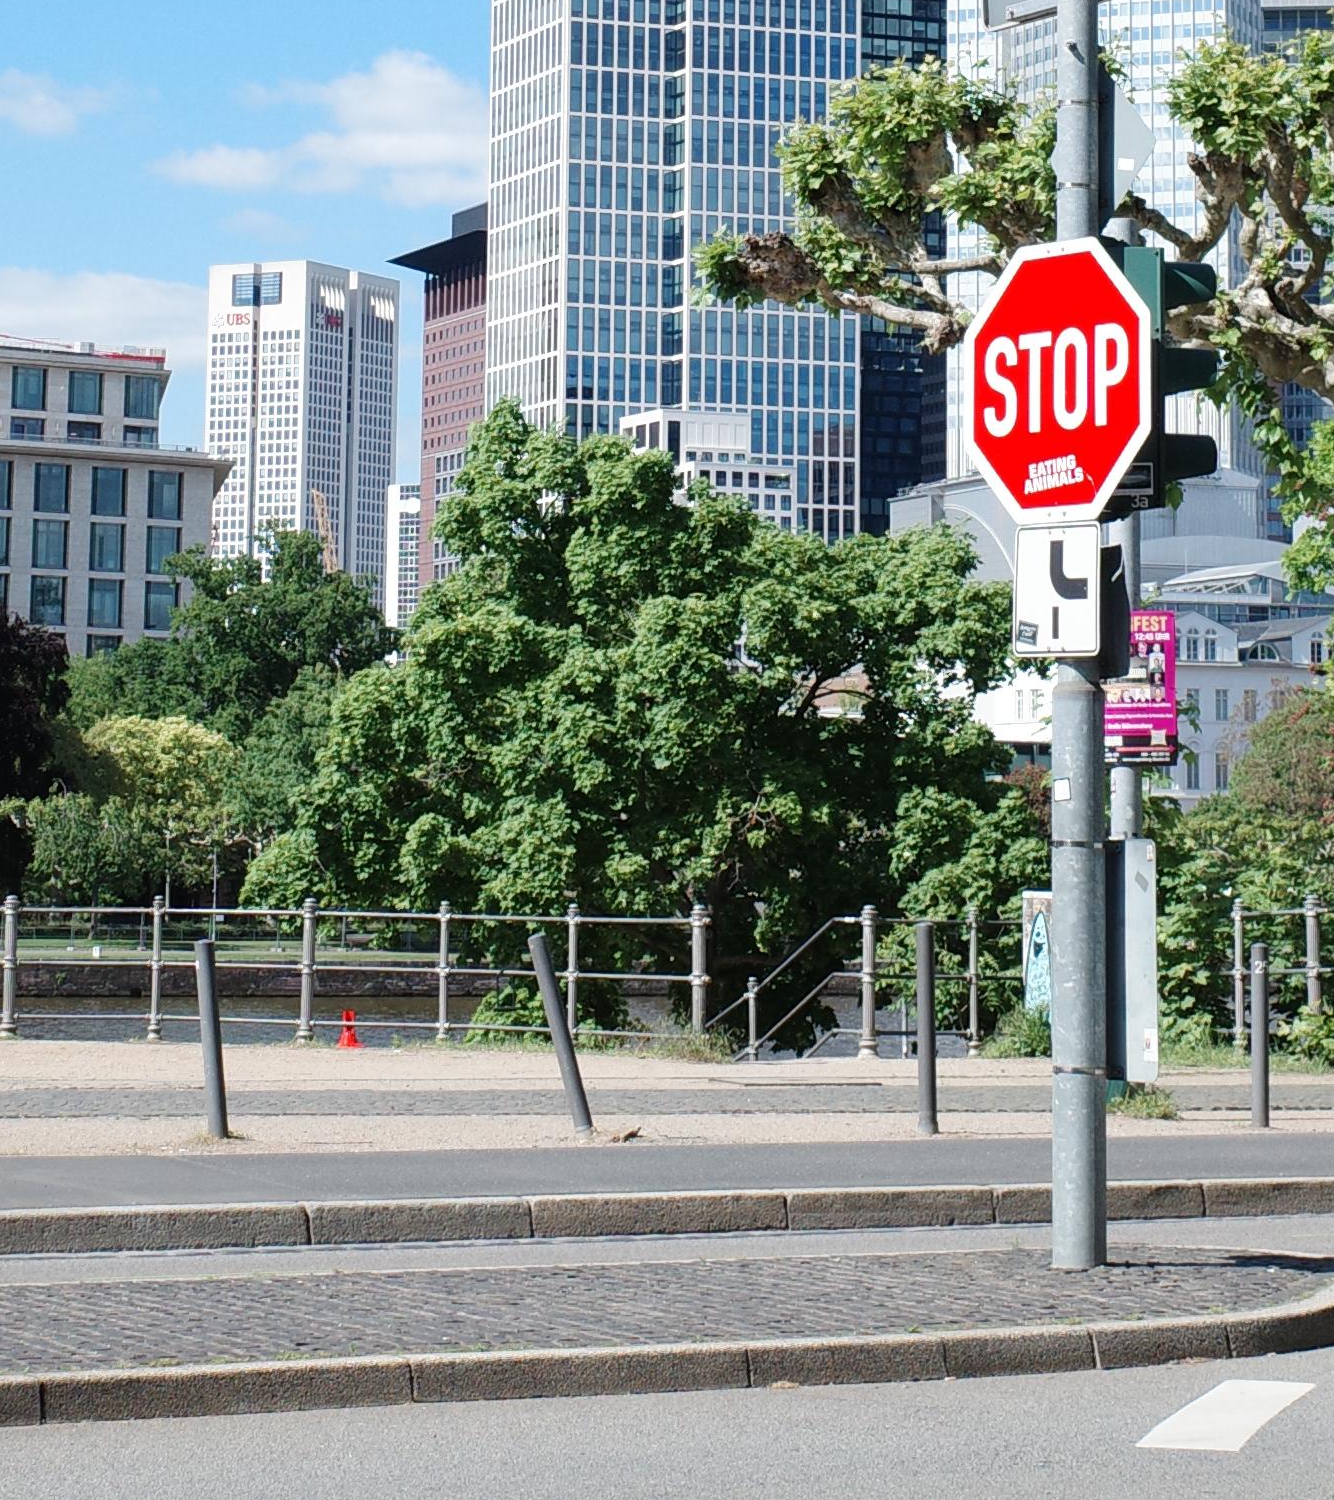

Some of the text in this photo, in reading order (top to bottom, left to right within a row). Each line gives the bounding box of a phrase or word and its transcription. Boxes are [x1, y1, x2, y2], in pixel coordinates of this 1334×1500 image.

[227, 313, 251, 326] UBS
[983, 322, 1129, 438] STOP
[1028, 454, 1077, 479] EATING
[1024, 467, 1085, 495] ANIMALS
[1130, 493, 1149, 508] 3a
[1131, 616, 1168, 632] FEST
